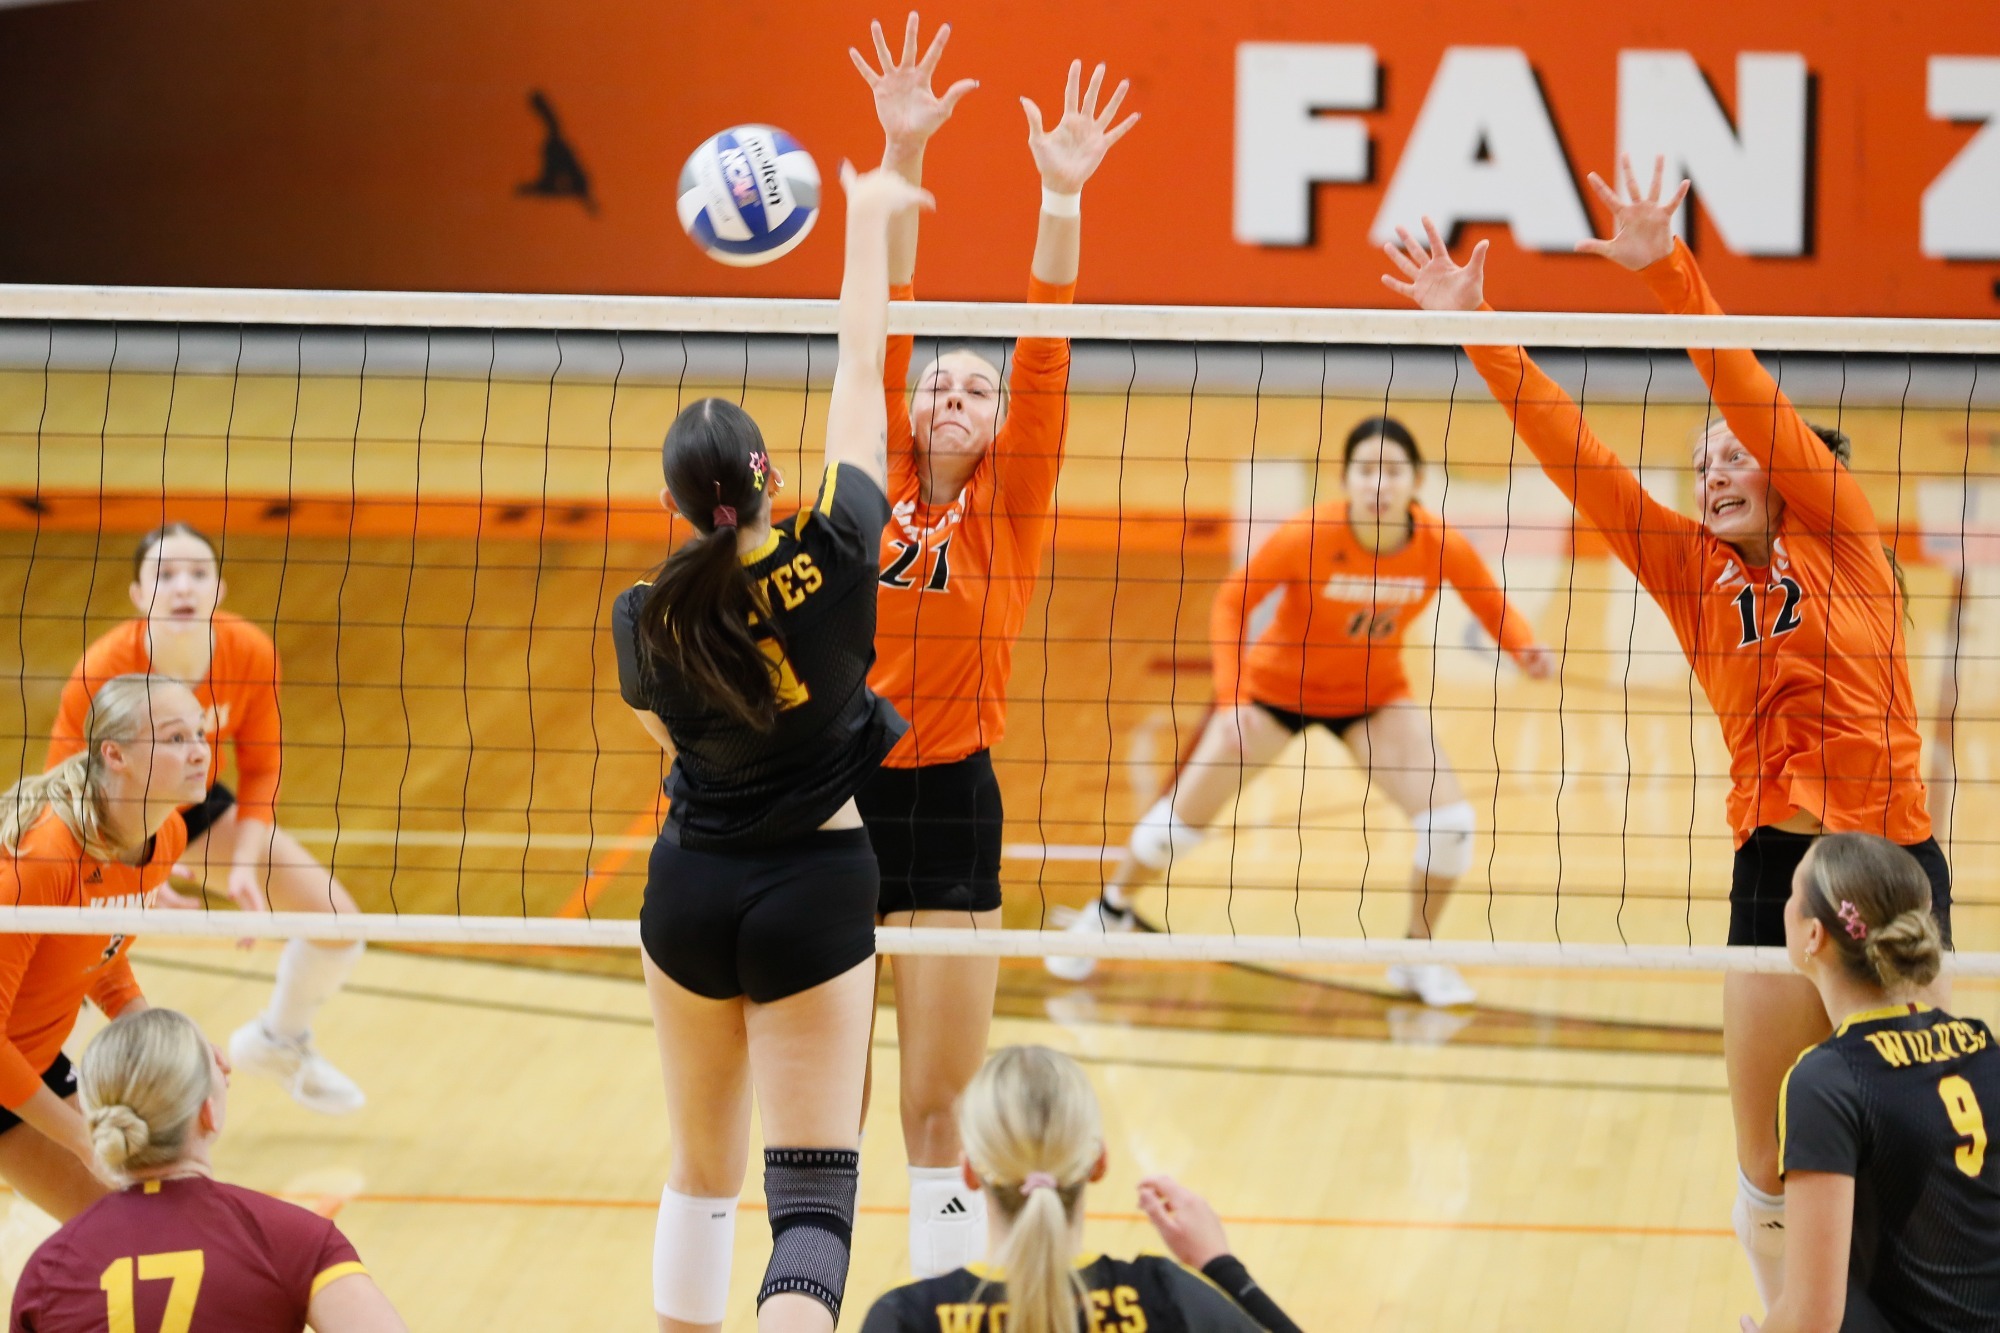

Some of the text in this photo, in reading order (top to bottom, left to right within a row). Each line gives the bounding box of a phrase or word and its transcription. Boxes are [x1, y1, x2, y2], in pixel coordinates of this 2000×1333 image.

[1232, 42, 1814, 256] FAN
[878, 530, 951, 593] 21
[1731, 576, 1803, 649] 12
[1938, 1074, 1988, 1179] 9
[100, 1248, 205, 1333] 17
